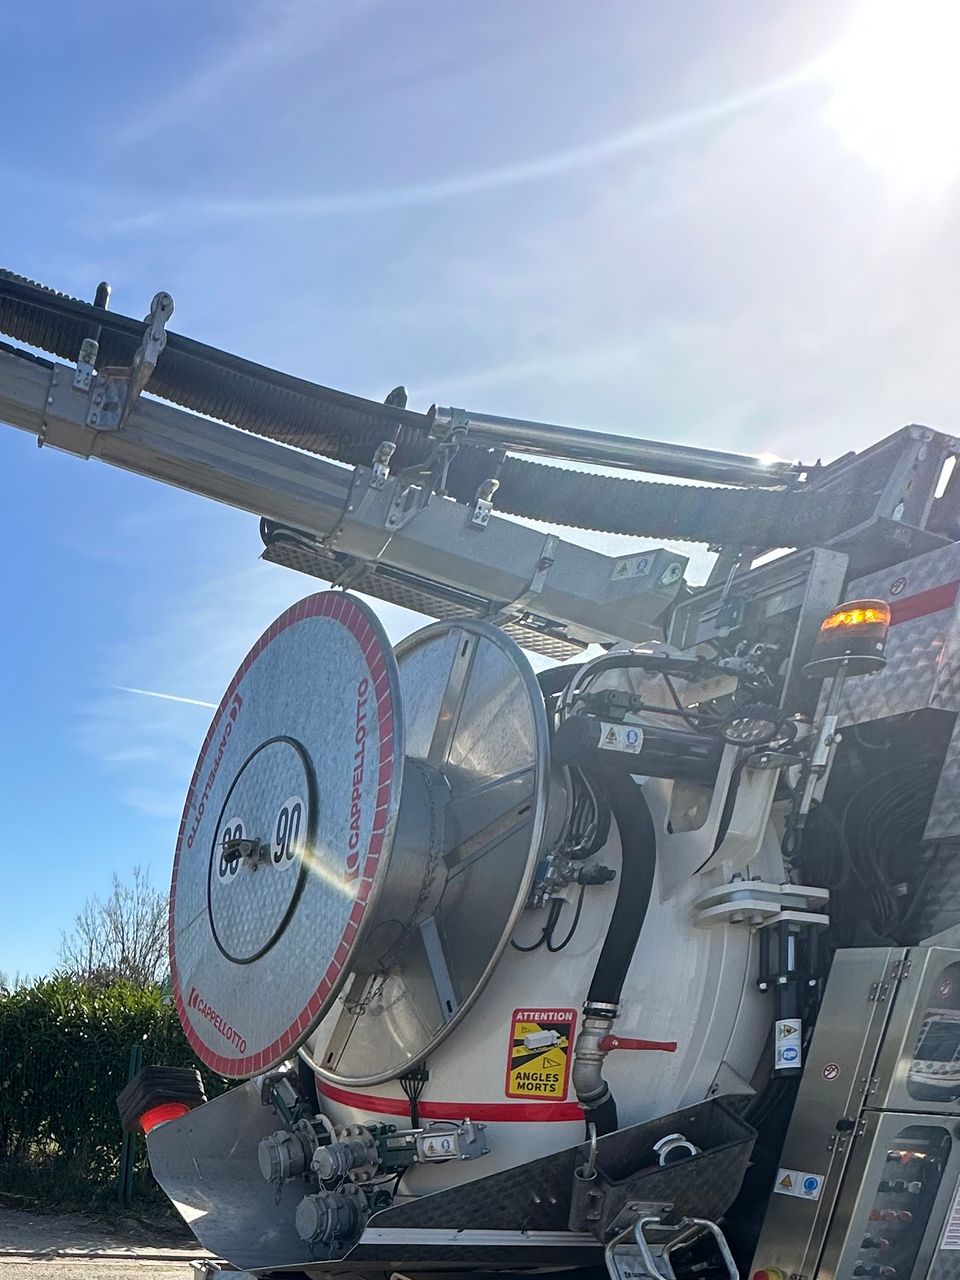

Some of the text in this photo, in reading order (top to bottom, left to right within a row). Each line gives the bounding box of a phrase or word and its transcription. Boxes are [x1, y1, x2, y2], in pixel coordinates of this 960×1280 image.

[187, 721, 232, 849] CAPPELLOTTO
[348, 678, 369, 849] CAPPELLOTTO
[273, 802, 302, 864] 90
[197, 999, 247, 1054] CAPPELLOTTO
[516, 1012, 573, 1021] ATTENTION
[515, 1072, 559, 1082] ANGLES
[517, 1081, 556, 1092] MORTS
